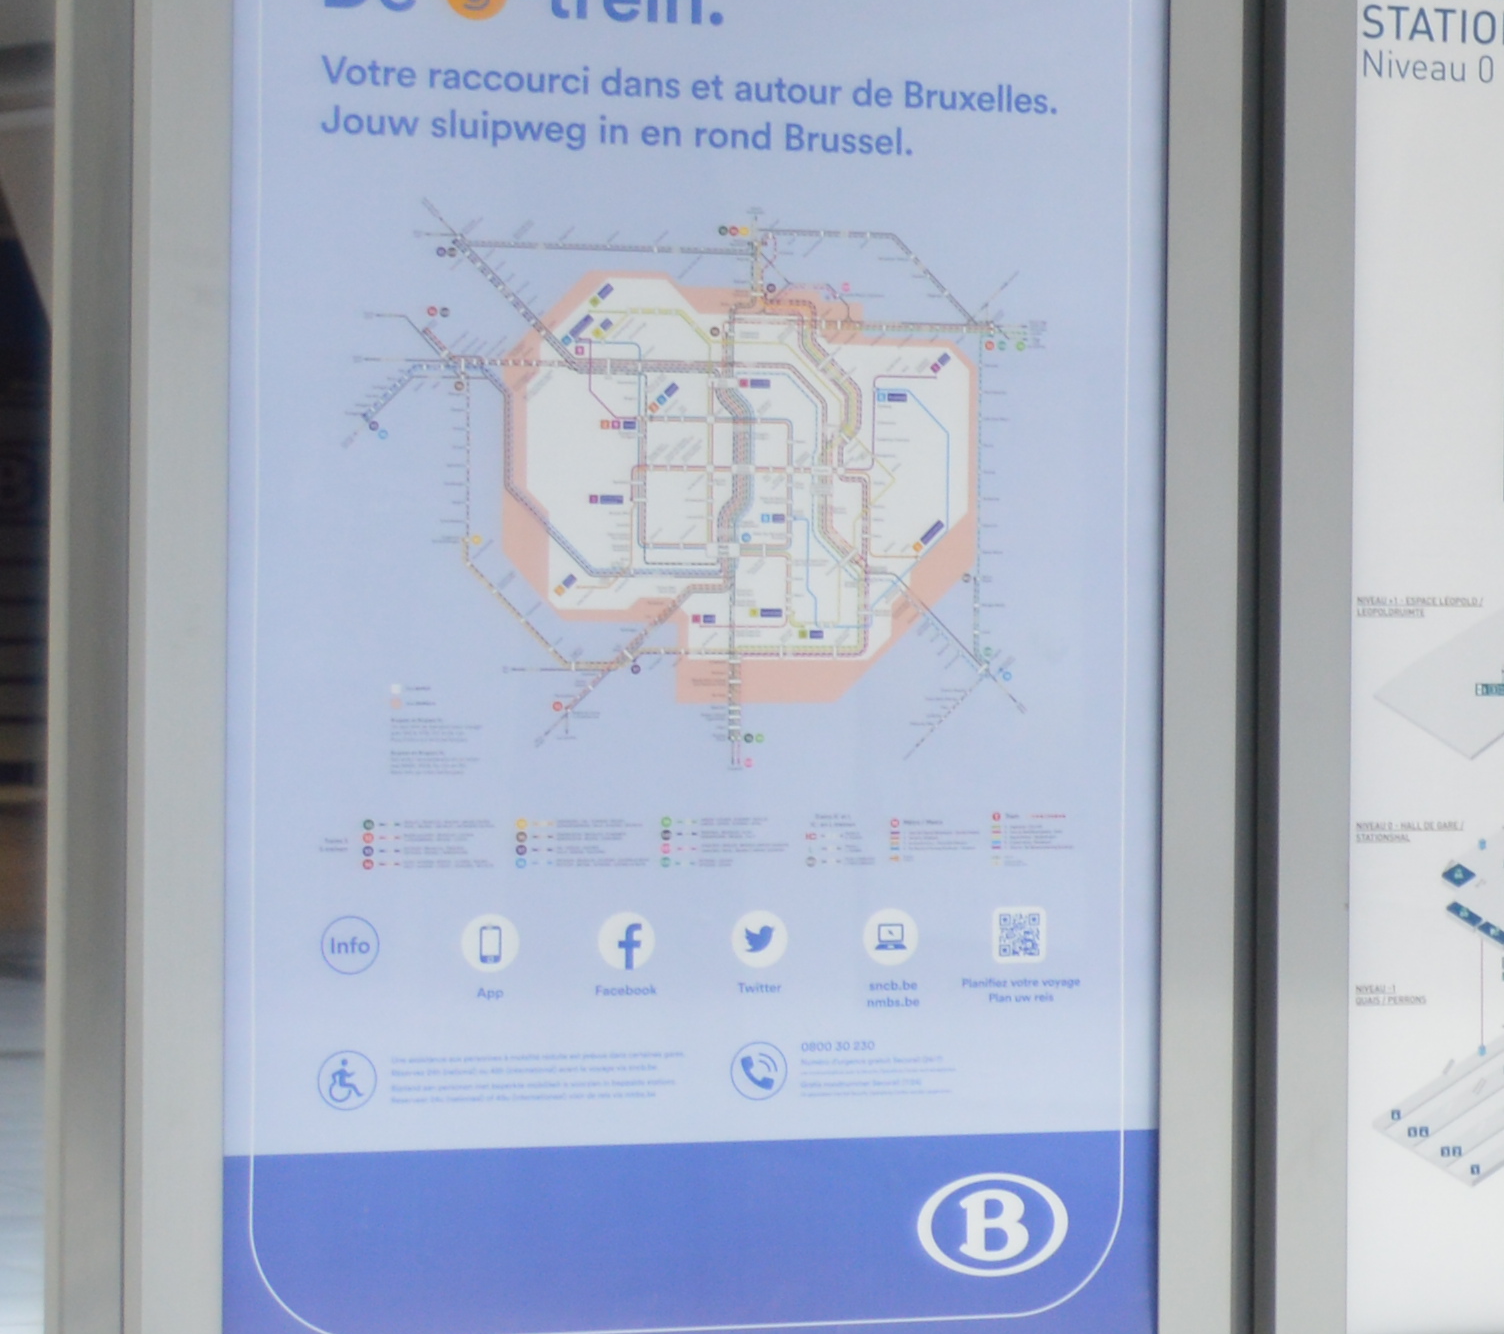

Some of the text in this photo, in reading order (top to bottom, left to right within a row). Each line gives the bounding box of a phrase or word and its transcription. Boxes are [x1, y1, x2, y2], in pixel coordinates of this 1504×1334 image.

[1363, 49, 1465, 82] Niveau
[1478, 55, 1494, 83] 0
[321, 55, 1056, 114] Votre raccourci dans et autour de Bruxelles.
[321, 105, 912, 155] Jouw sluipweg in en rond Brussel.
[329, 936, 370, 958] Info
[594, 983, 658, 997] Facebook
[737, 980, 782, 995] Twitter
[868, 979, 919, 992] sncb.be
[961, 976, 1081, 990] Planifiez votre voyage
[476, 986, 505, 1002] App
[988, 992, 1054, 1004] Plan uw reis
[866, 995, 921, 1009] nmbs.be
[800, 1040, 876, 1053] 0800 30 230
